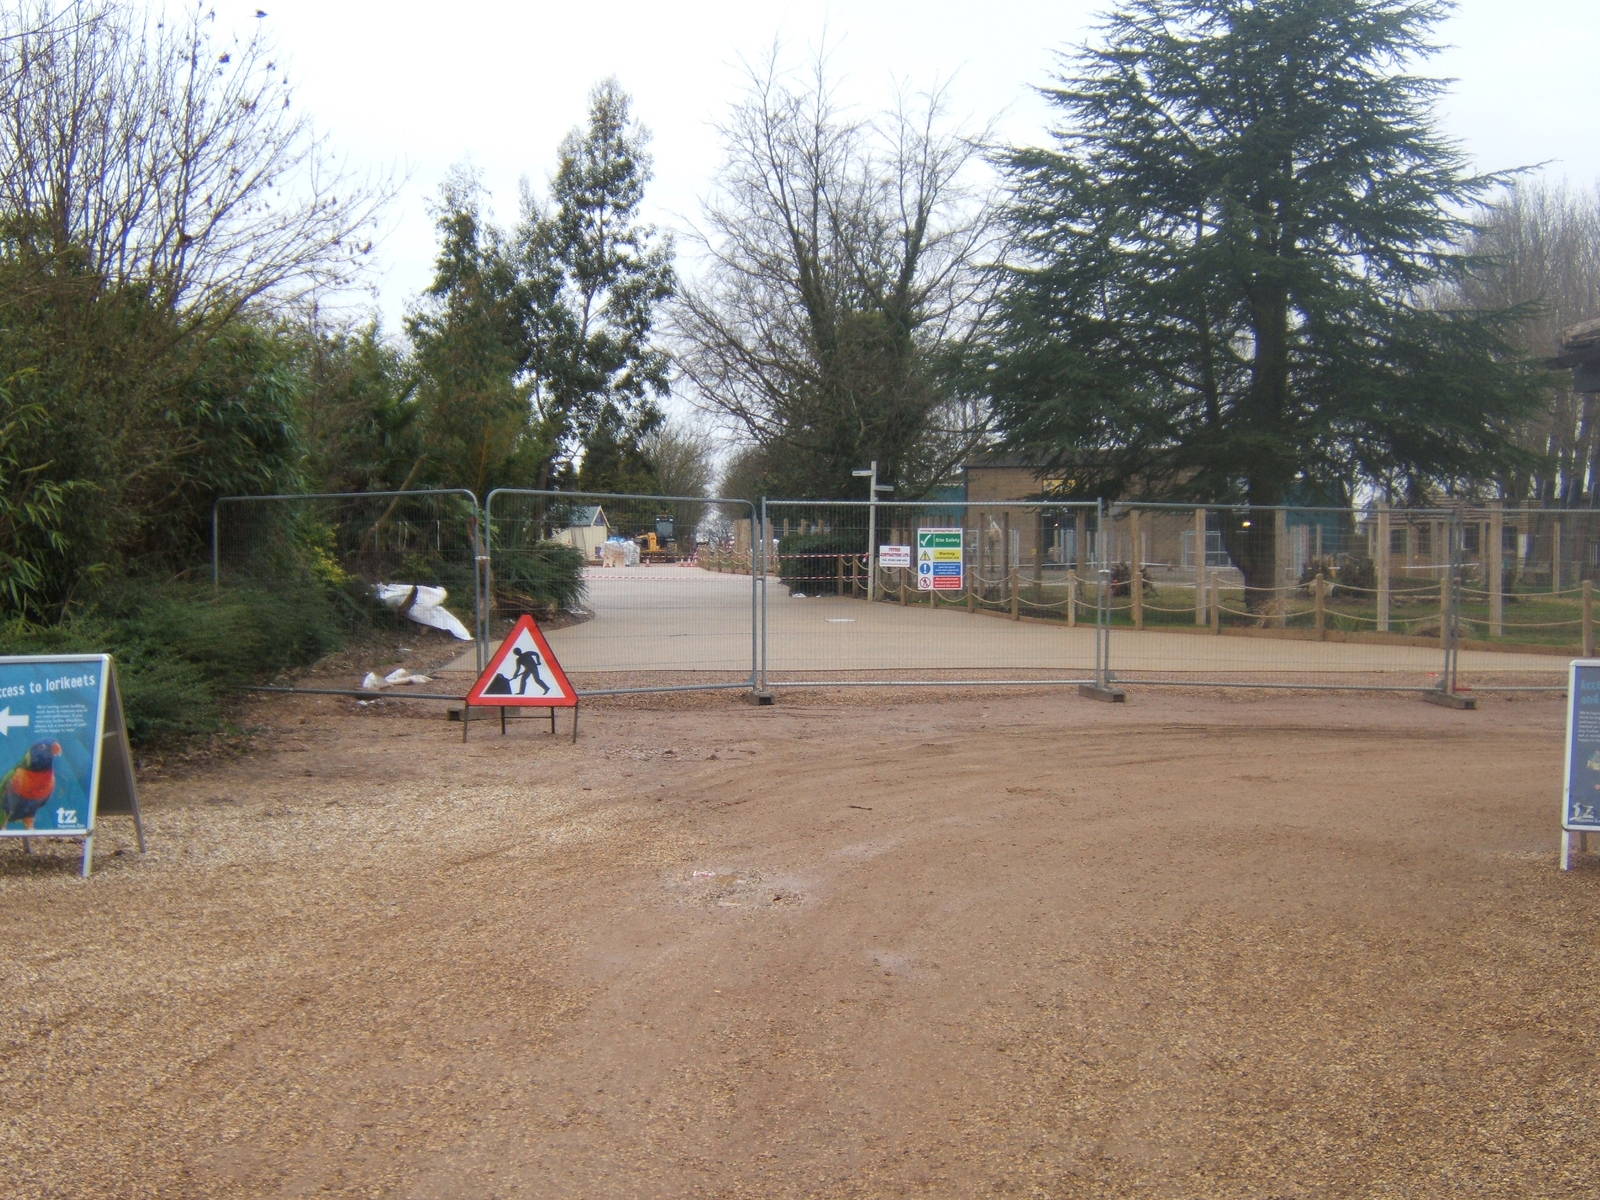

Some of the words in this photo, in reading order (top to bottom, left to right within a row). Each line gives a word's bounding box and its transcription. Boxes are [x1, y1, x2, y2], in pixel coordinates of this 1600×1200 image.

[30, 680, 42, 694] to
[46, 674, 96, 692] lorikeets
[56, 807, 77, 824] tz
